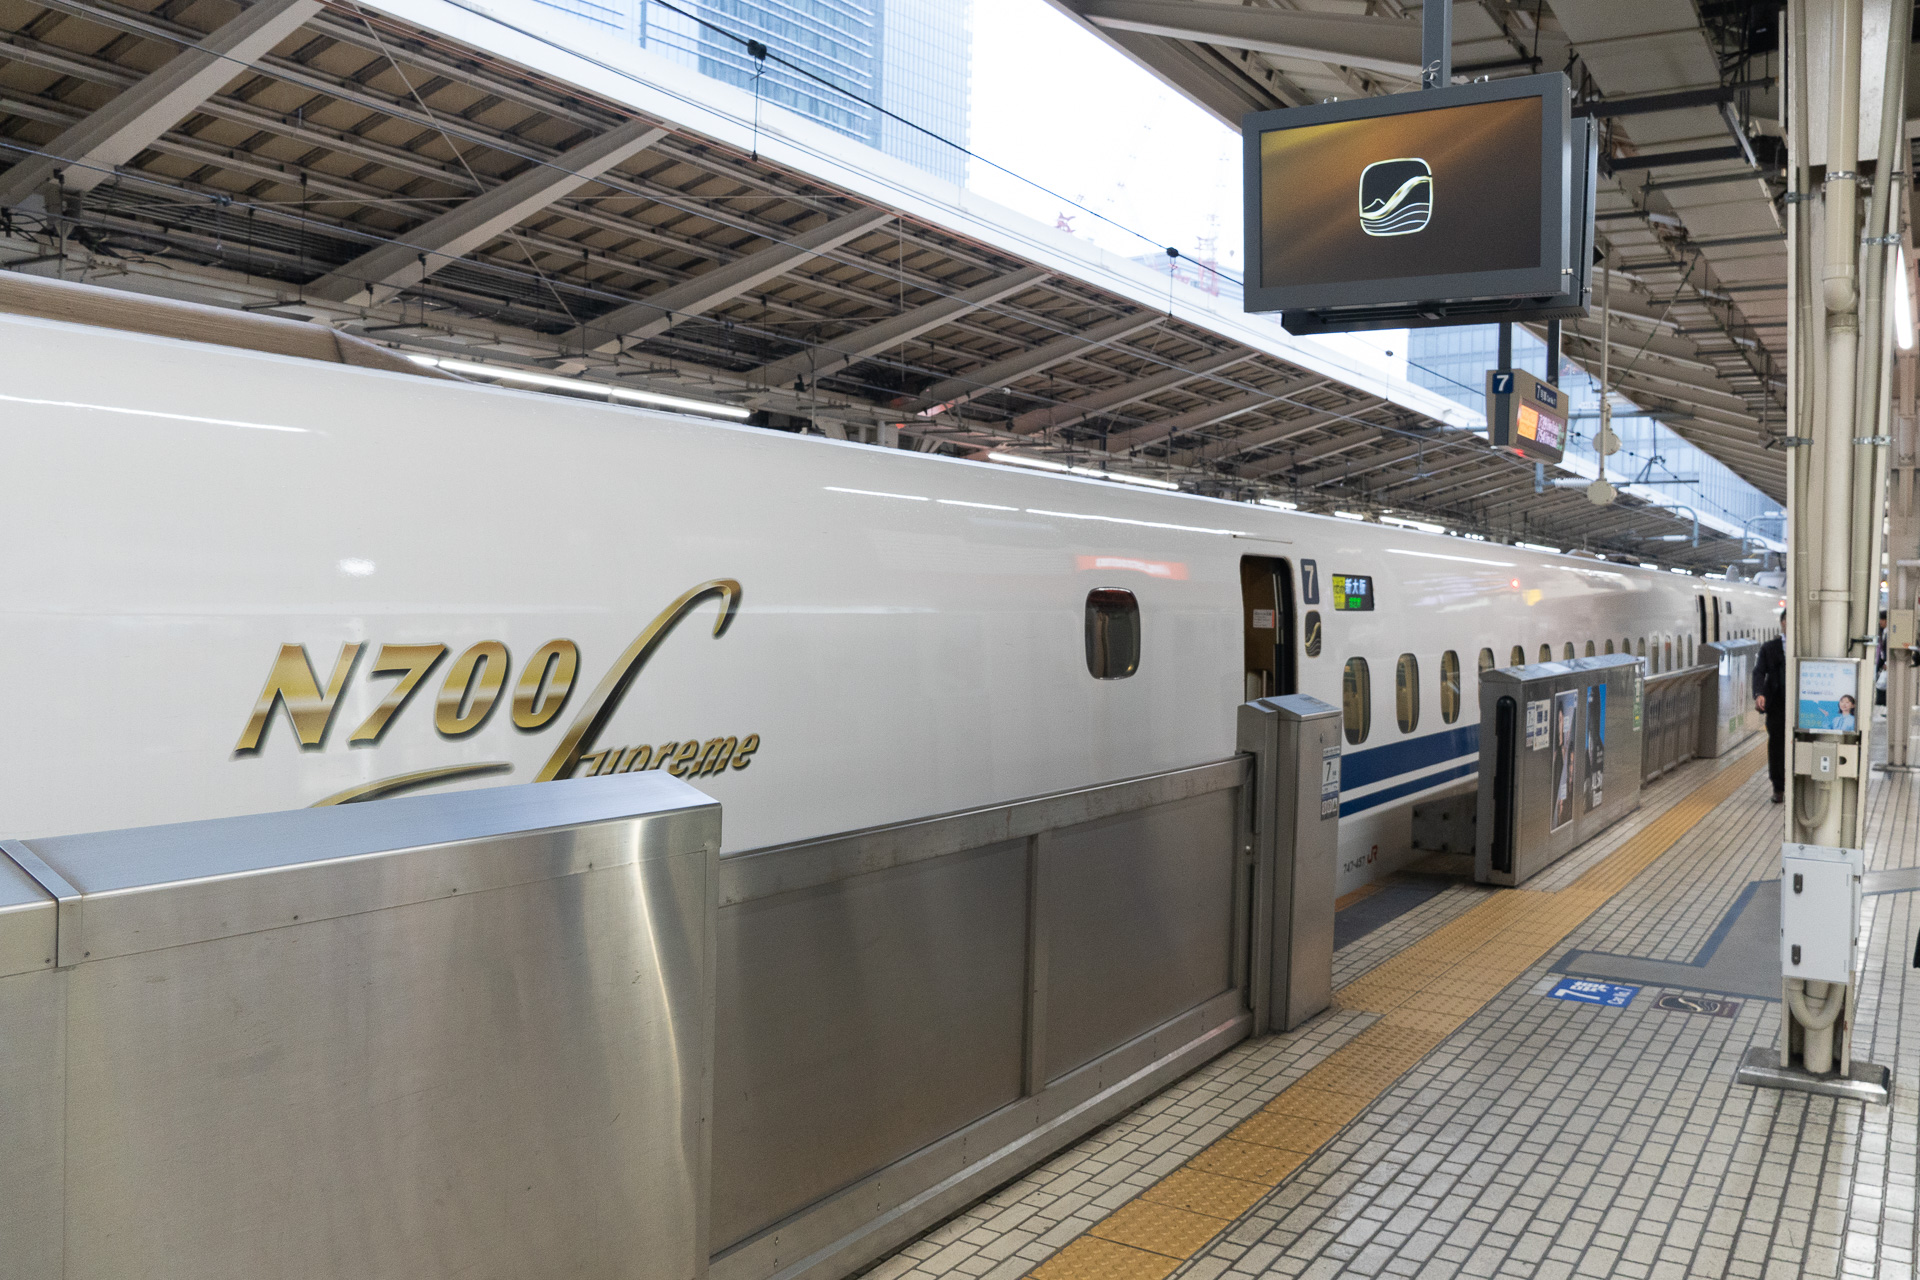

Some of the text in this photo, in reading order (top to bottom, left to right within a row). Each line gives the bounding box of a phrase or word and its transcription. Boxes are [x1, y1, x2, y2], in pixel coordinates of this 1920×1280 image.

[1496, 374, 1509, 392] 7
[1304, 565, 1313, 599] 7
[1345, 578, 1366, 595] 新大阪
[231, 638, 582, 759] N700
[1326, 761, 1332, 782] 7
[1367, 844, 1378, 864] JR
